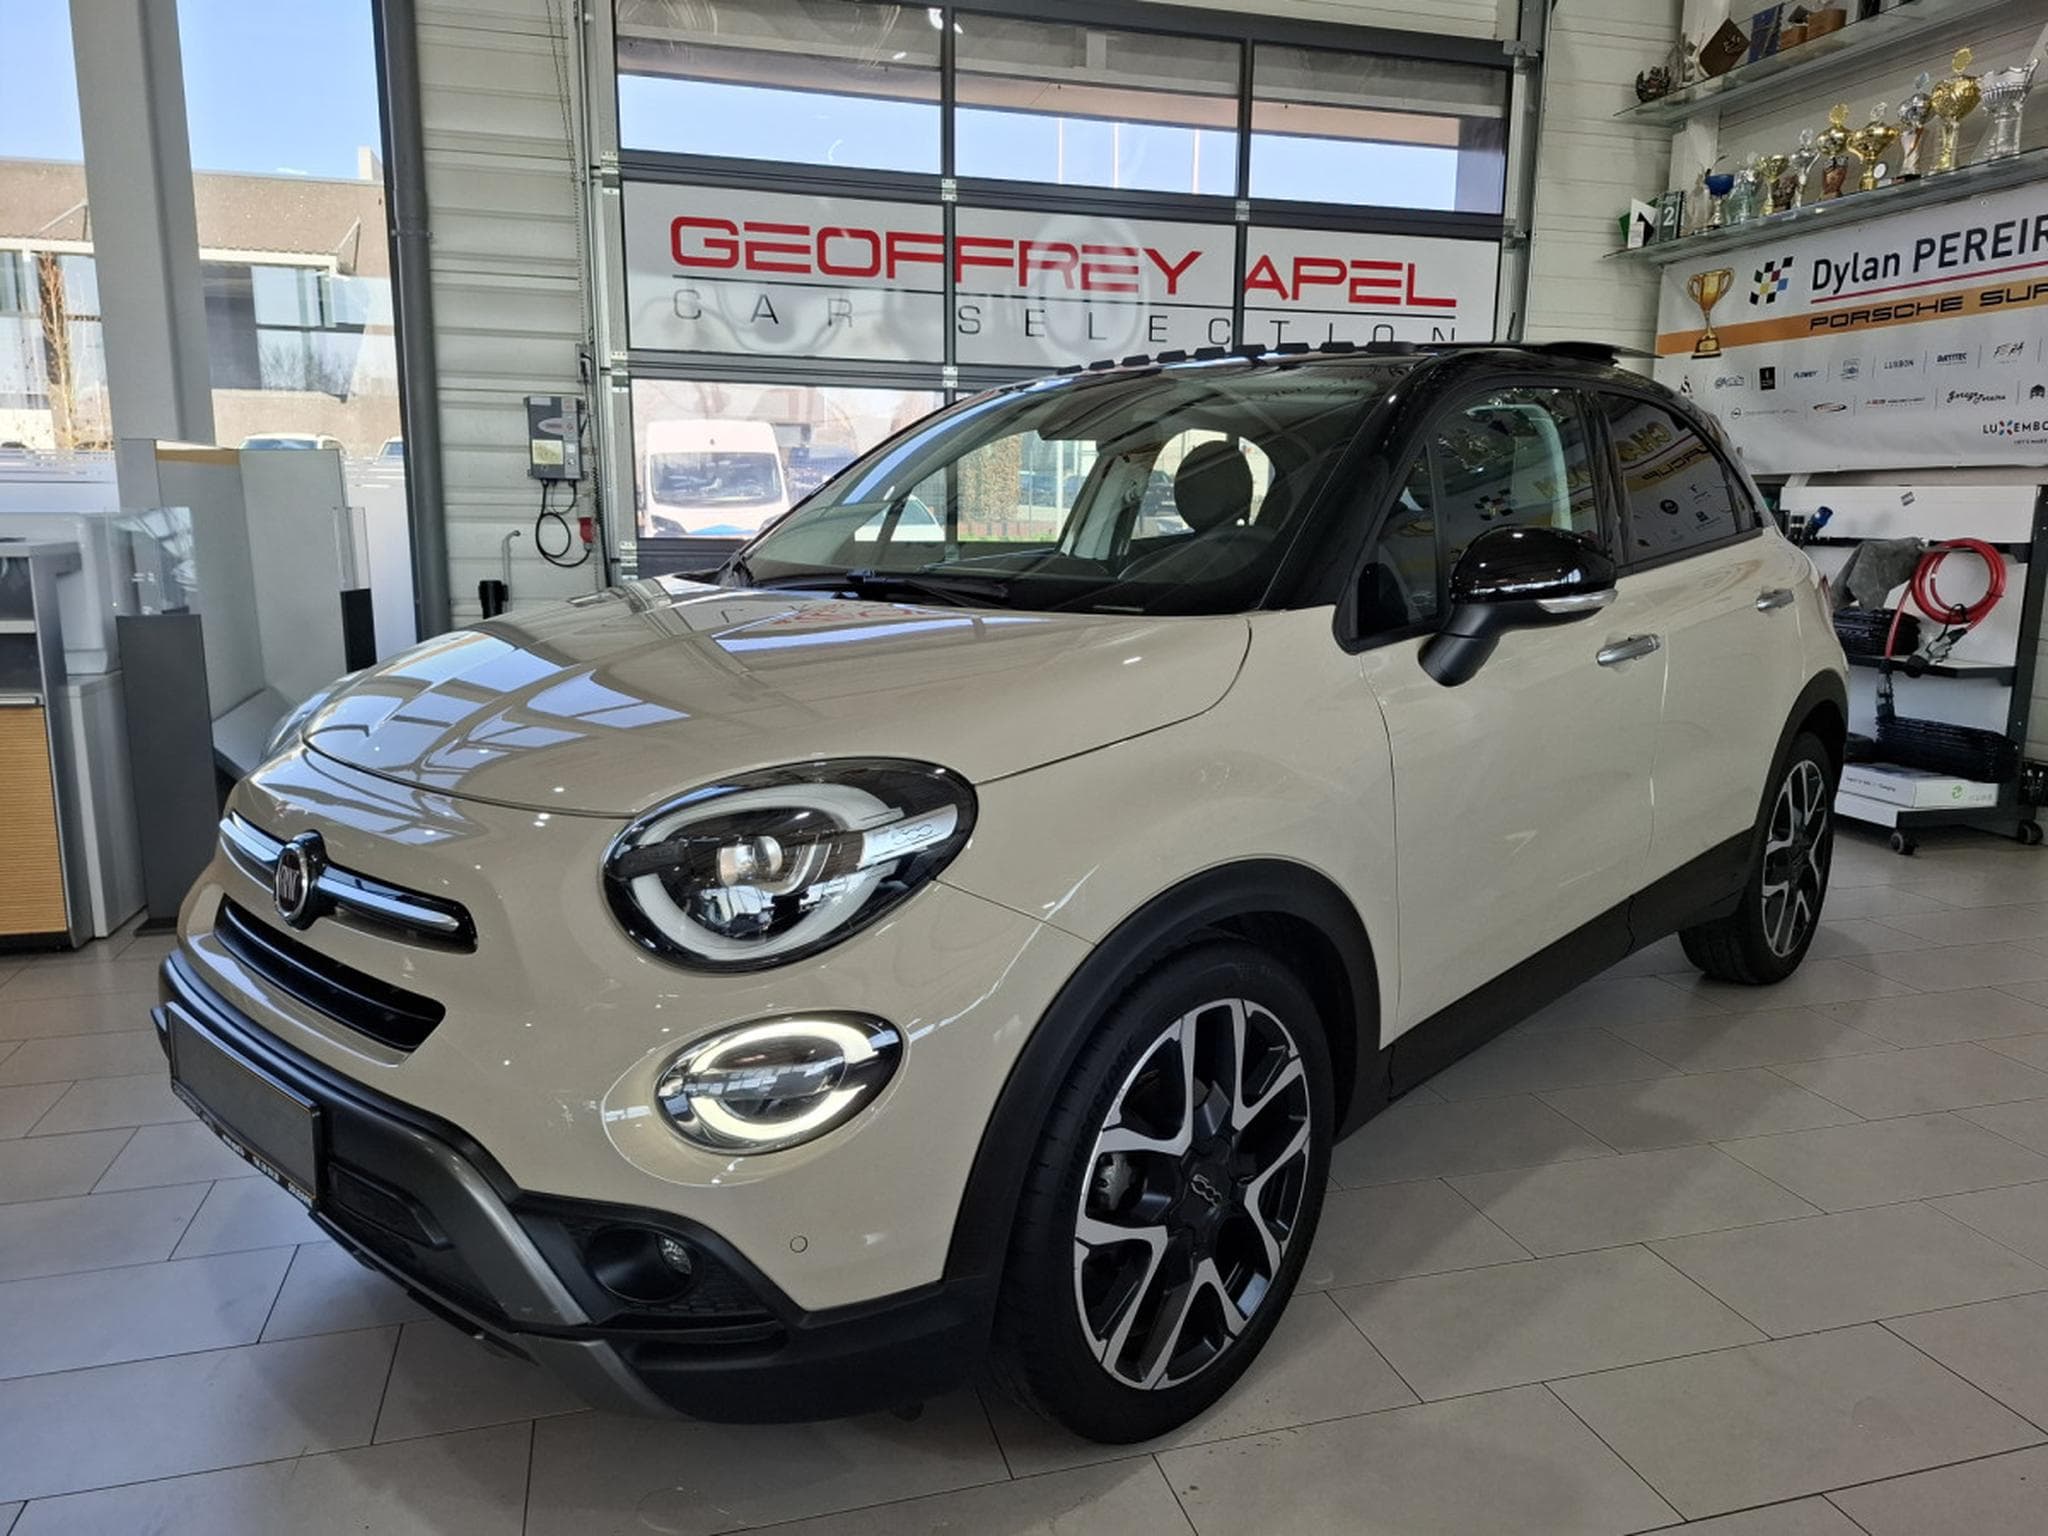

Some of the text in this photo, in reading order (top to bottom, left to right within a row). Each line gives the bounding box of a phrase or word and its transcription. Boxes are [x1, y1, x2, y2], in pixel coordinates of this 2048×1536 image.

[670, 215, 1457, 308] GEOFFREY APEL
[1812, 252, 1900, 295] Dylan
[673, 289, 1456, 345] CAR SELECTION
[1810, 296, 1963, 331] PORSCHE
